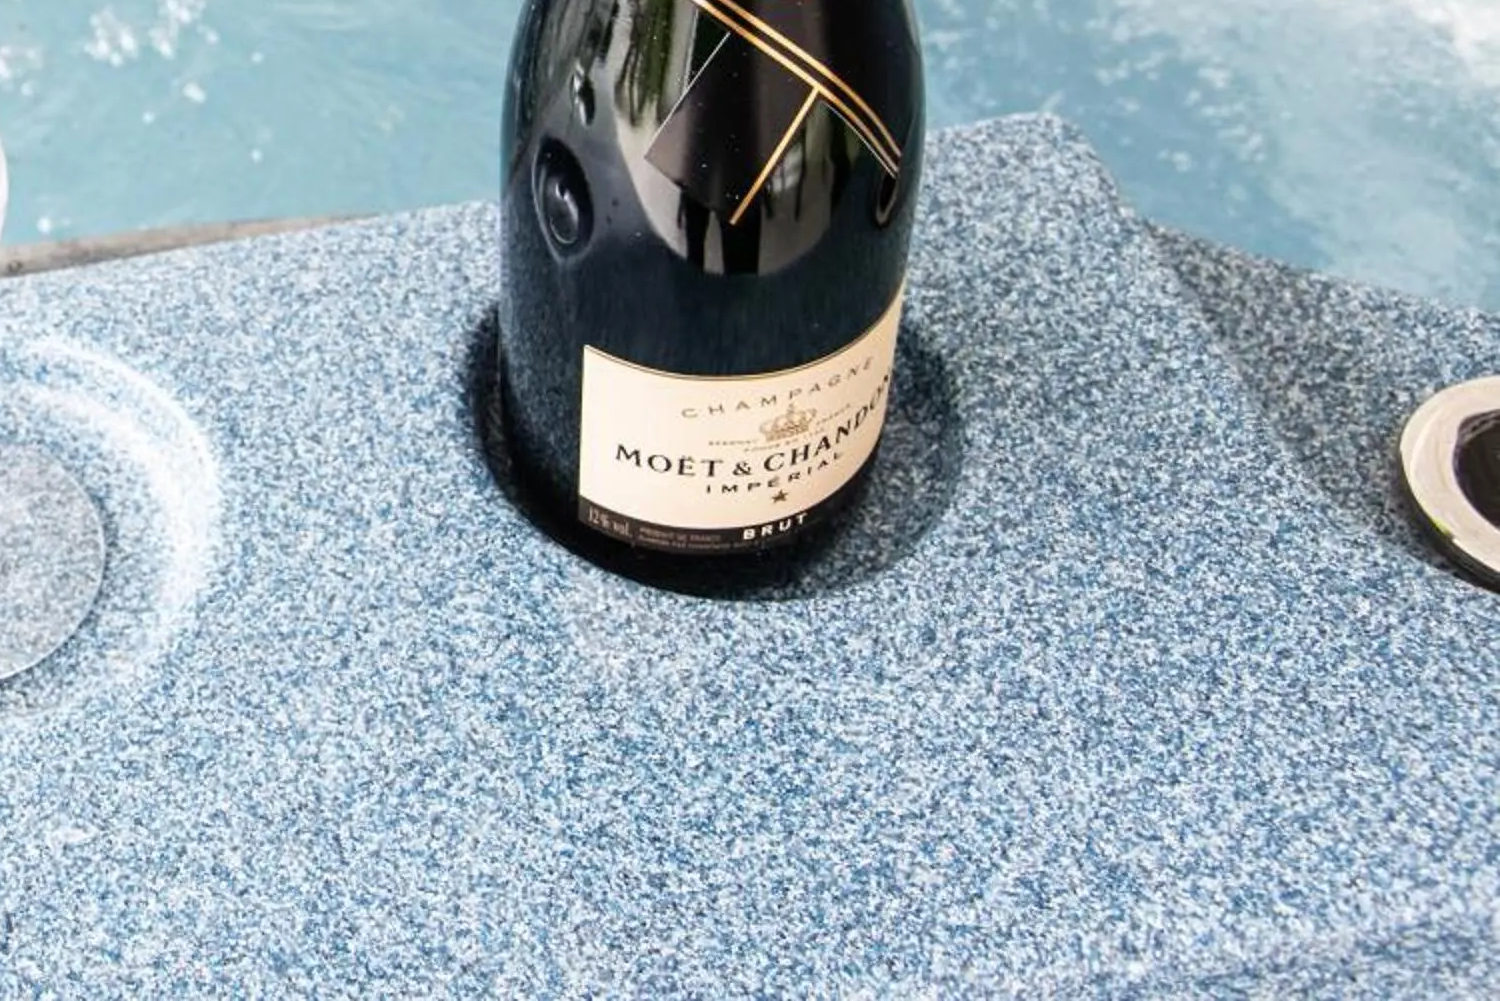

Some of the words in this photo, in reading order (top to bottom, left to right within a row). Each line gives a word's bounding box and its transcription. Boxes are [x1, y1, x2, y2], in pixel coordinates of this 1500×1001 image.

[680, 355, 875, 419] CHAMPAGNE
[615, 443, 725, 478] MOËT
[732, 460, 752, 477] &
[742, 511, 808, 540] BRUT
